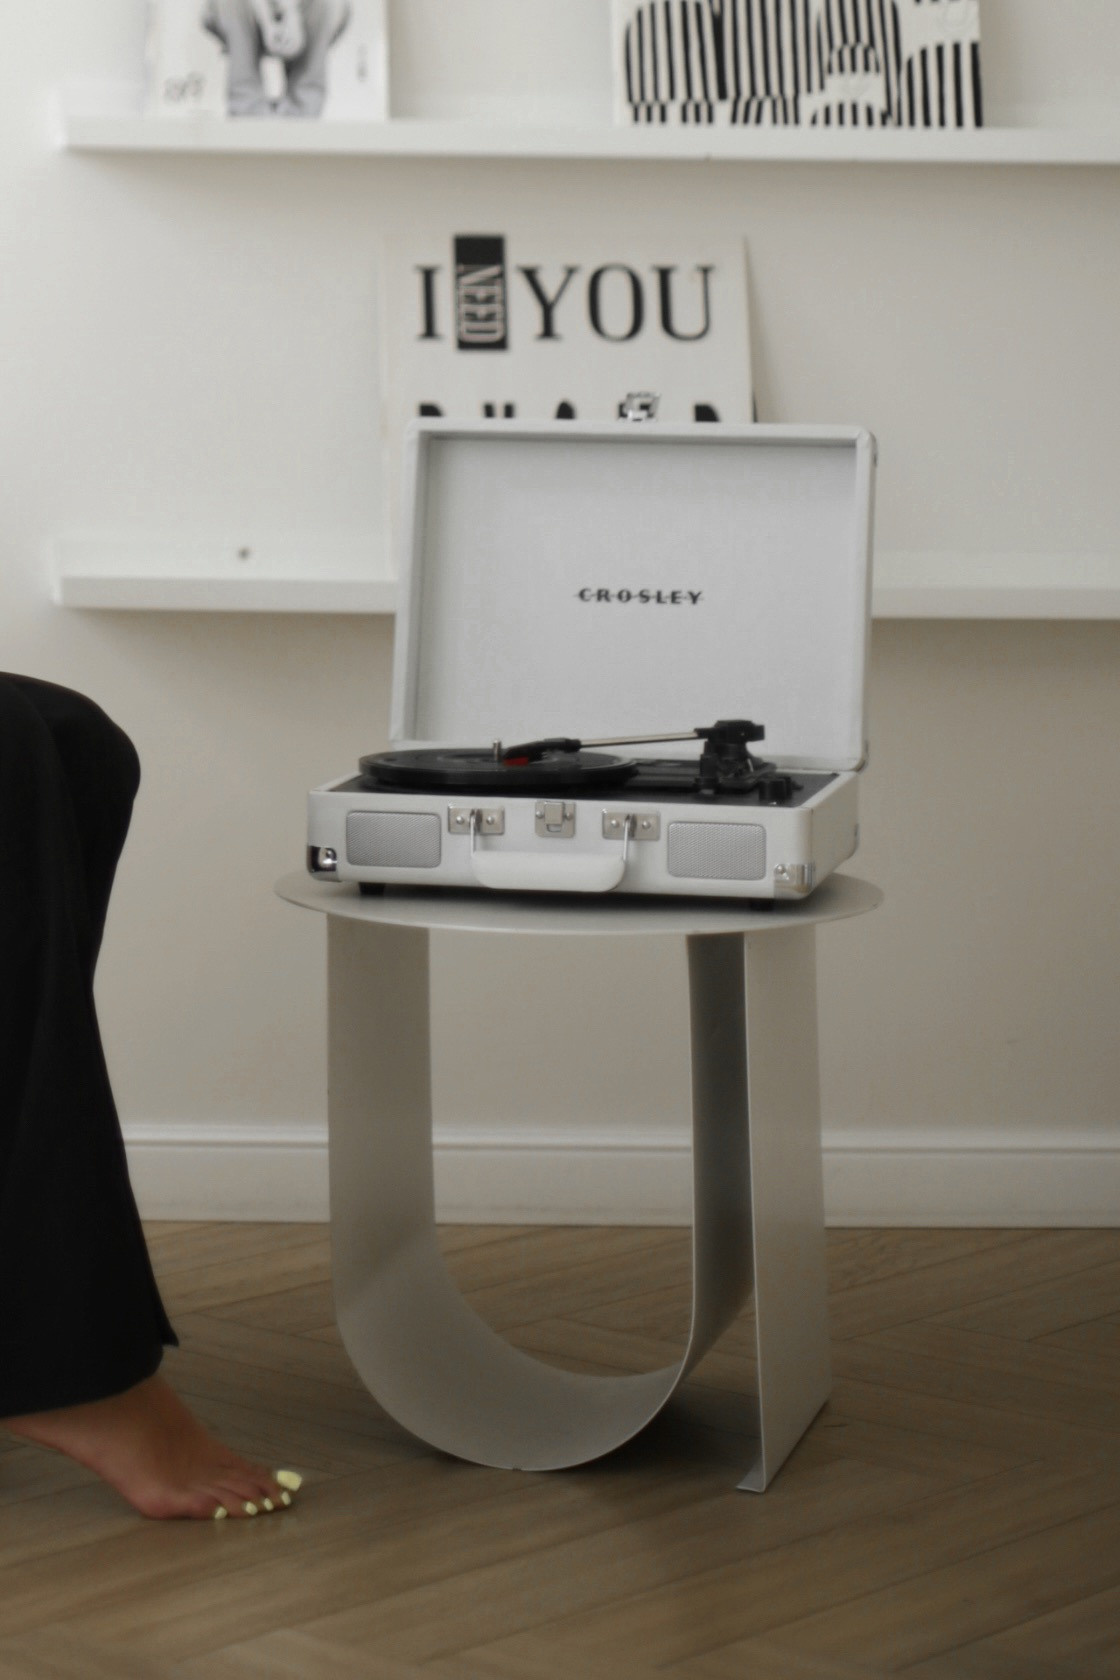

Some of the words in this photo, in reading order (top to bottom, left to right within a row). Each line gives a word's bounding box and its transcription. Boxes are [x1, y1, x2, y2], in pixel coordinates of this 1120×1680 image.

[416, 264, 443, 341] I
[515, 263, 715, 342] YOU
[578, 587, 703, 606] CROSLEY
